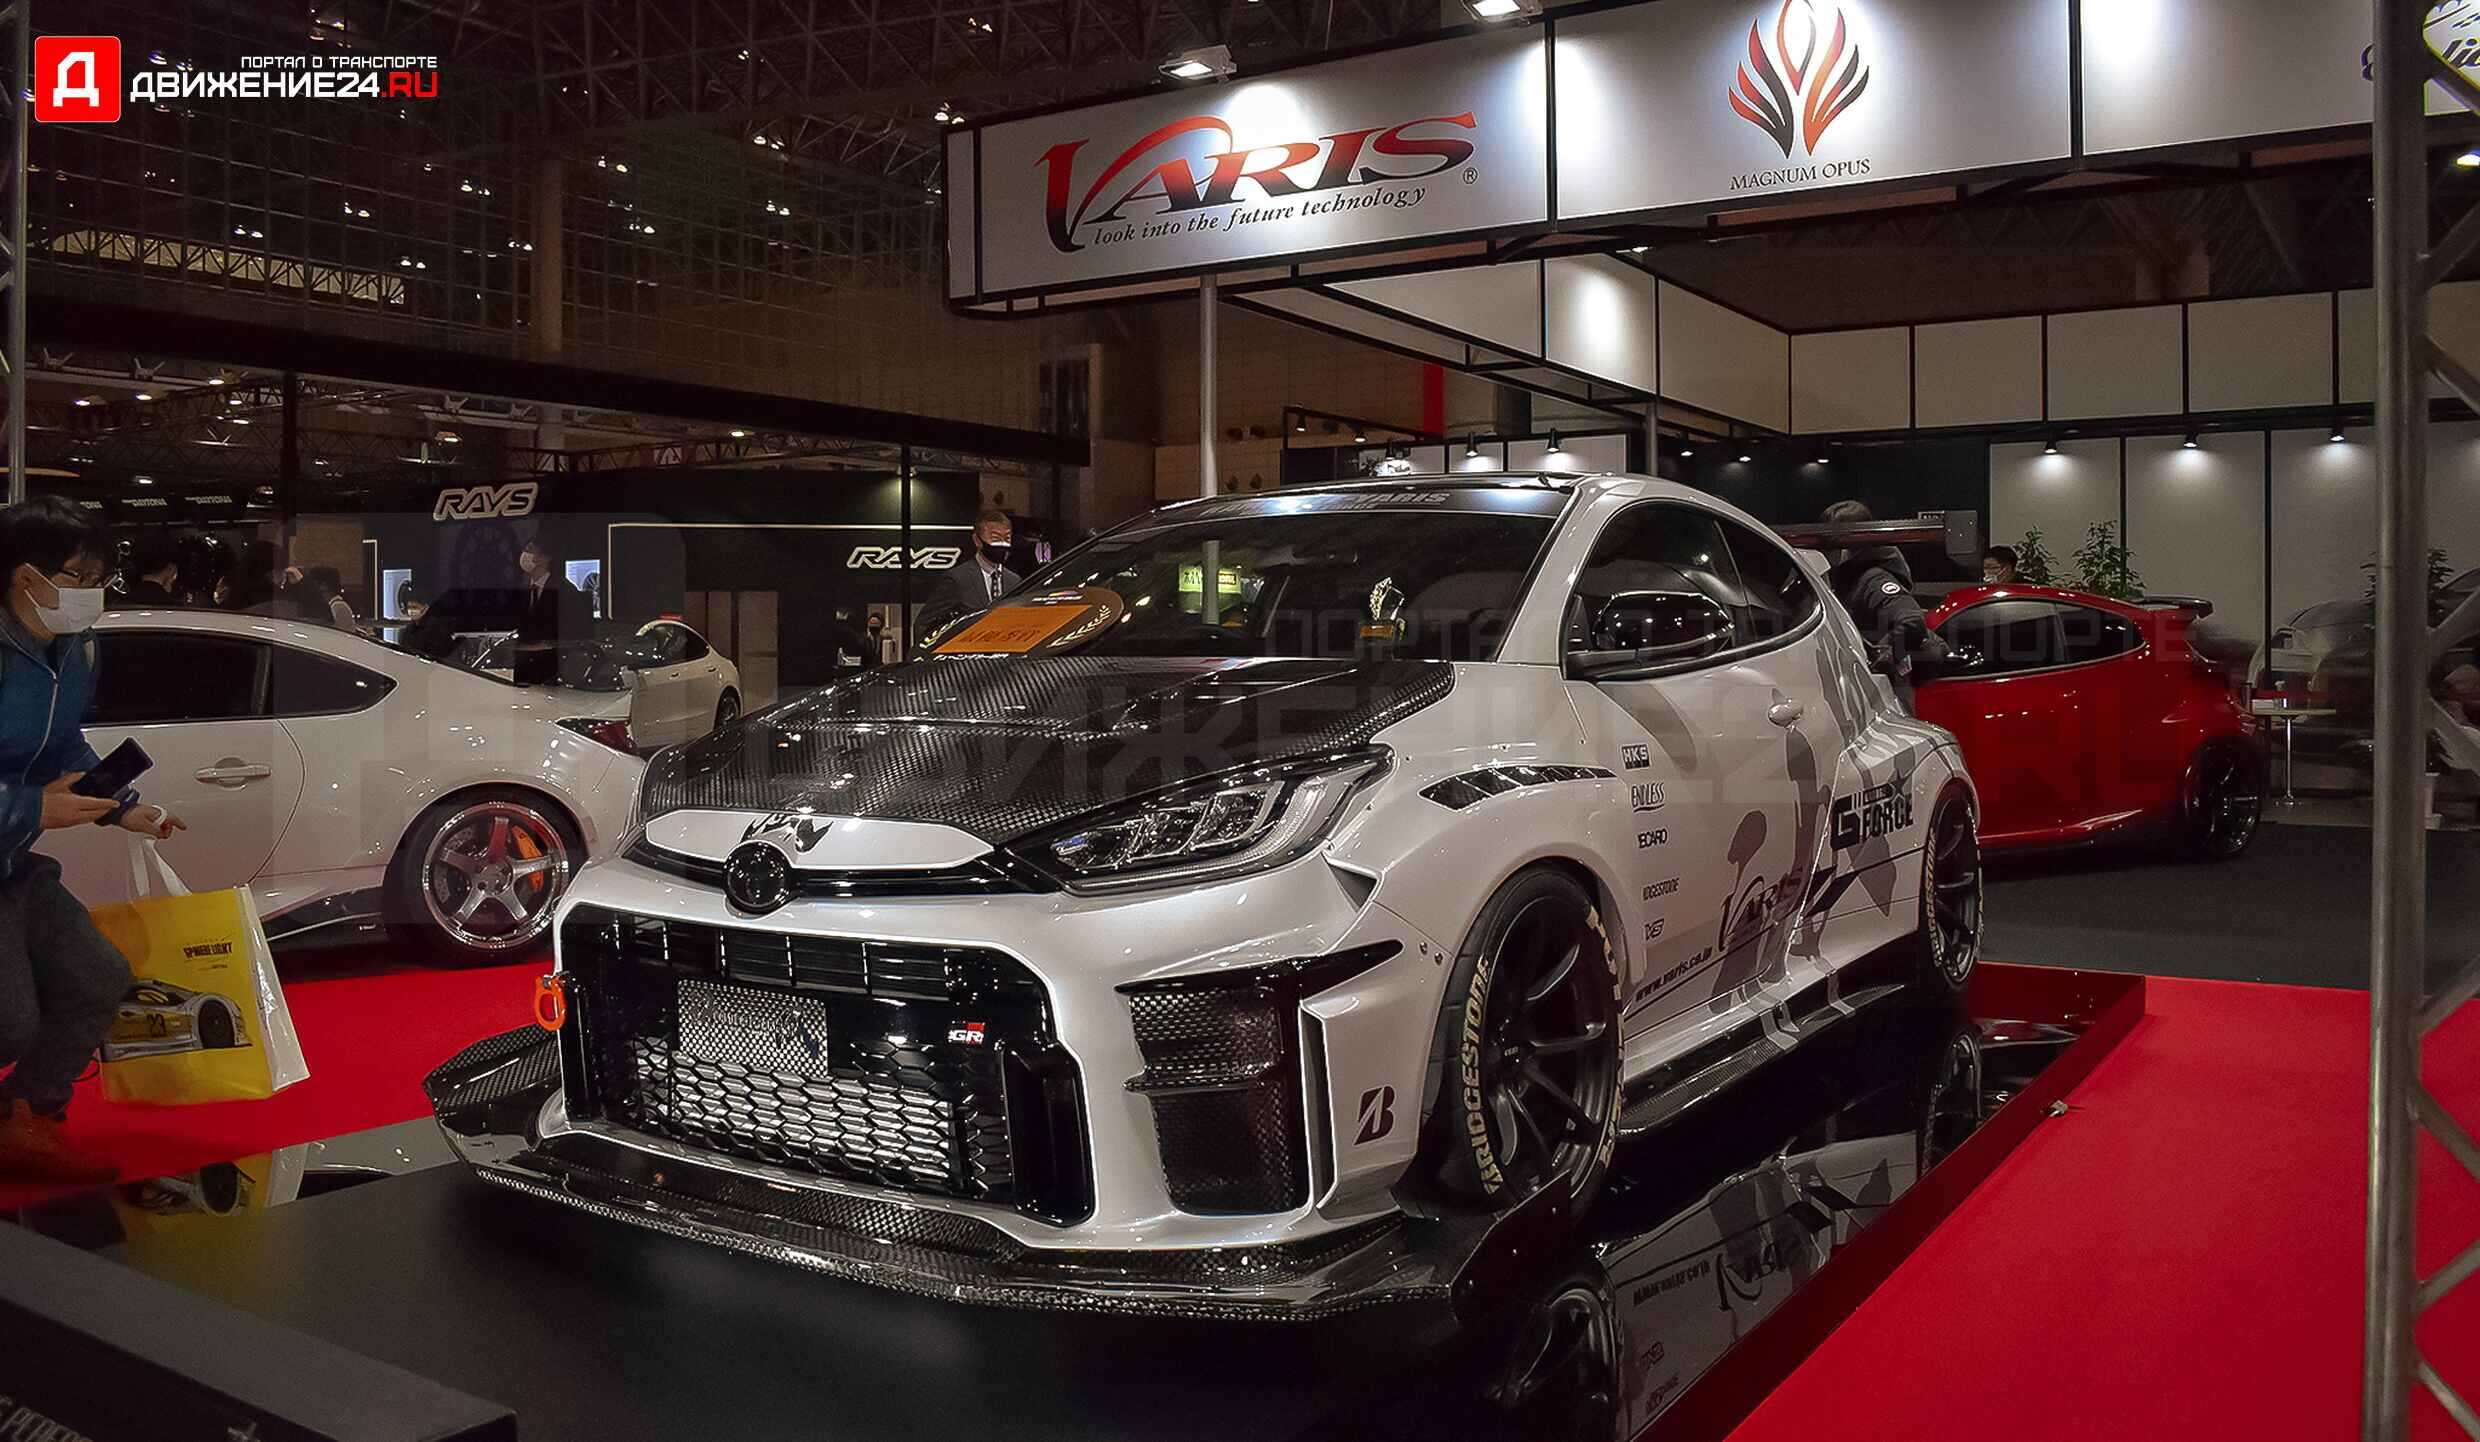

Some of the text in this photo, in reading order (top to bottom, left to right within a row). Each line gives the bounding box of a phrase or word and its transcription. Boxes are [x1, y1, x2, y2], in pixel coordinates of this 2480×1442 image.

[1034, 112, 1477, 254] VARIS
[1730, 158, 1871, 190] MAGNUM OPUS
[1093, 185, 1427, 246] look into the future technology
[433, 482, 538, 520] RAYS
[847, 546, 961, 568] RAYS
[1622, 746, 1650, 764] HKS
[1631, 782, 1665, 808] ENDLESS
[1638, 828, 1668, 850] ECARO
[948, 1027, 985, 1044] GR
